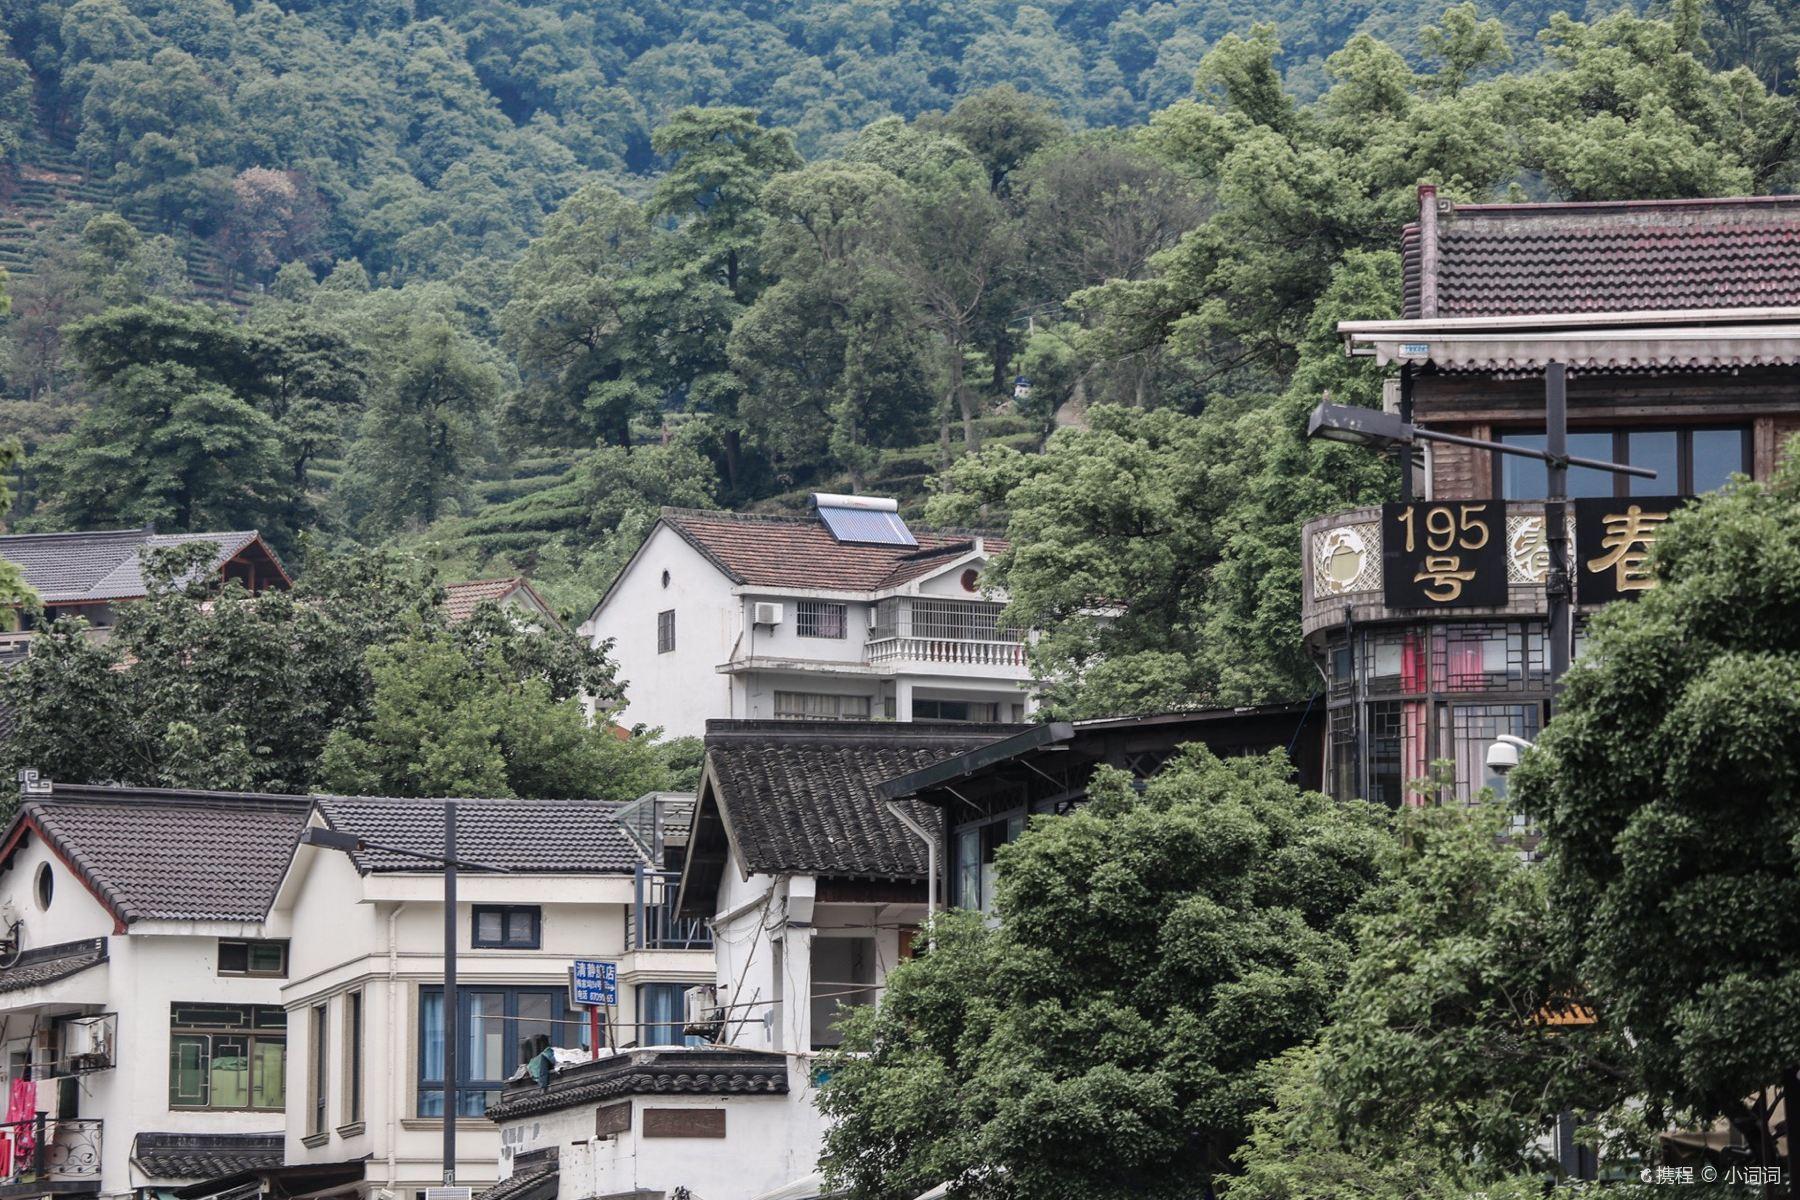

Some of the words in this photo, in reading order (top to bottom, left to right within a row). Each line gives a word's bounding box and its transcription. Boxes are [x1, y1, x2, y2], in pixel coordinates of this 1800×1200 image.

[1397, 504, 1490, 552] 195
[1586, 504, 1669, 593] 春
[1412, 555, 1475, 602] 号
